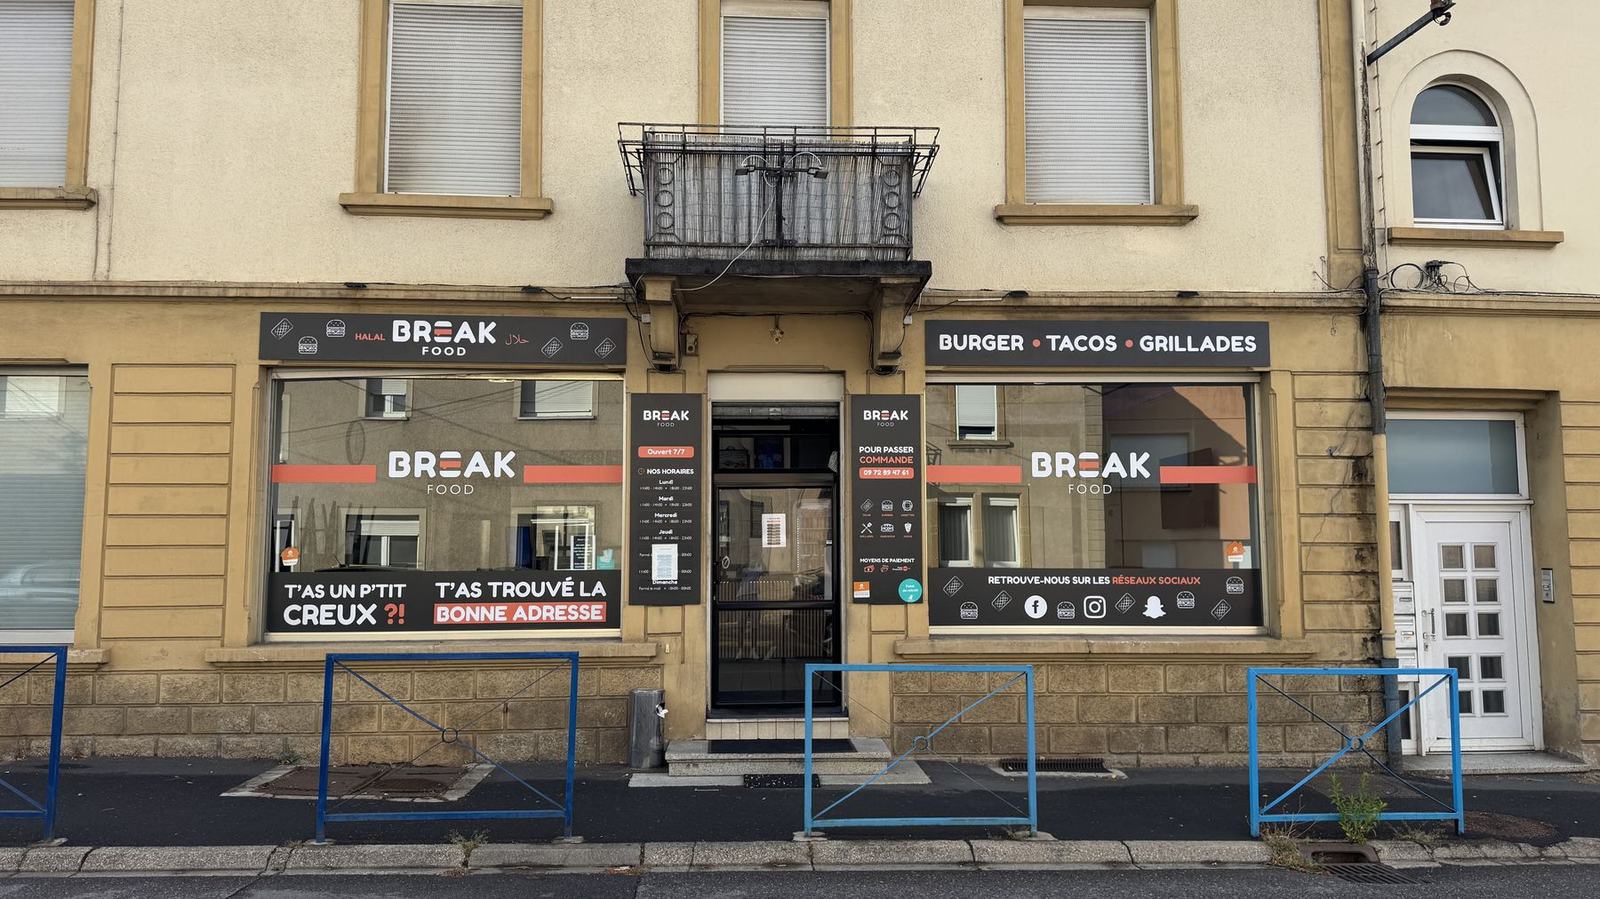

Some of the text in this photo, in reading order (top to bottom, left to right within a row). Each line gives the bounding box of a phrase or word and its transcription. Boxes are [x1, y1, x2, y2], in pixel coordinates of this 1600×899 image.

[354, 332, 386, 340] HALAL
[392, 319, 496, 345] BREAK
[506, 333, 528, 346] حلال
[940, 334, 1256, 353] BURGER TACOS GRILLADES
[422, 346, 466, 356] FOOD
[644, 409, 690, 421] BREAK
[864, 409, 908, 421] BREAK
[388, 450, 516, 479] BREAK
[860, 456, 914, 464] COMMANDE
[1030, 451, 1152, 480] BREAK
[428, 484, 474, 495] FOOD
[1068, 483, 1114, 496] FOOD
[988, 574, 1200, 585] RETROUVE-NOUS SUR LES RÉSEAUX SOCIAUX
[284, 583, 406, 599] T'AS UN P'TIT
[434, 576, 606, 599] T'AS TROUVÉ LA
[284, 603, 404, 626] CREUX ?!
[436, 604, 604, 623] BONNE ADRESSE
